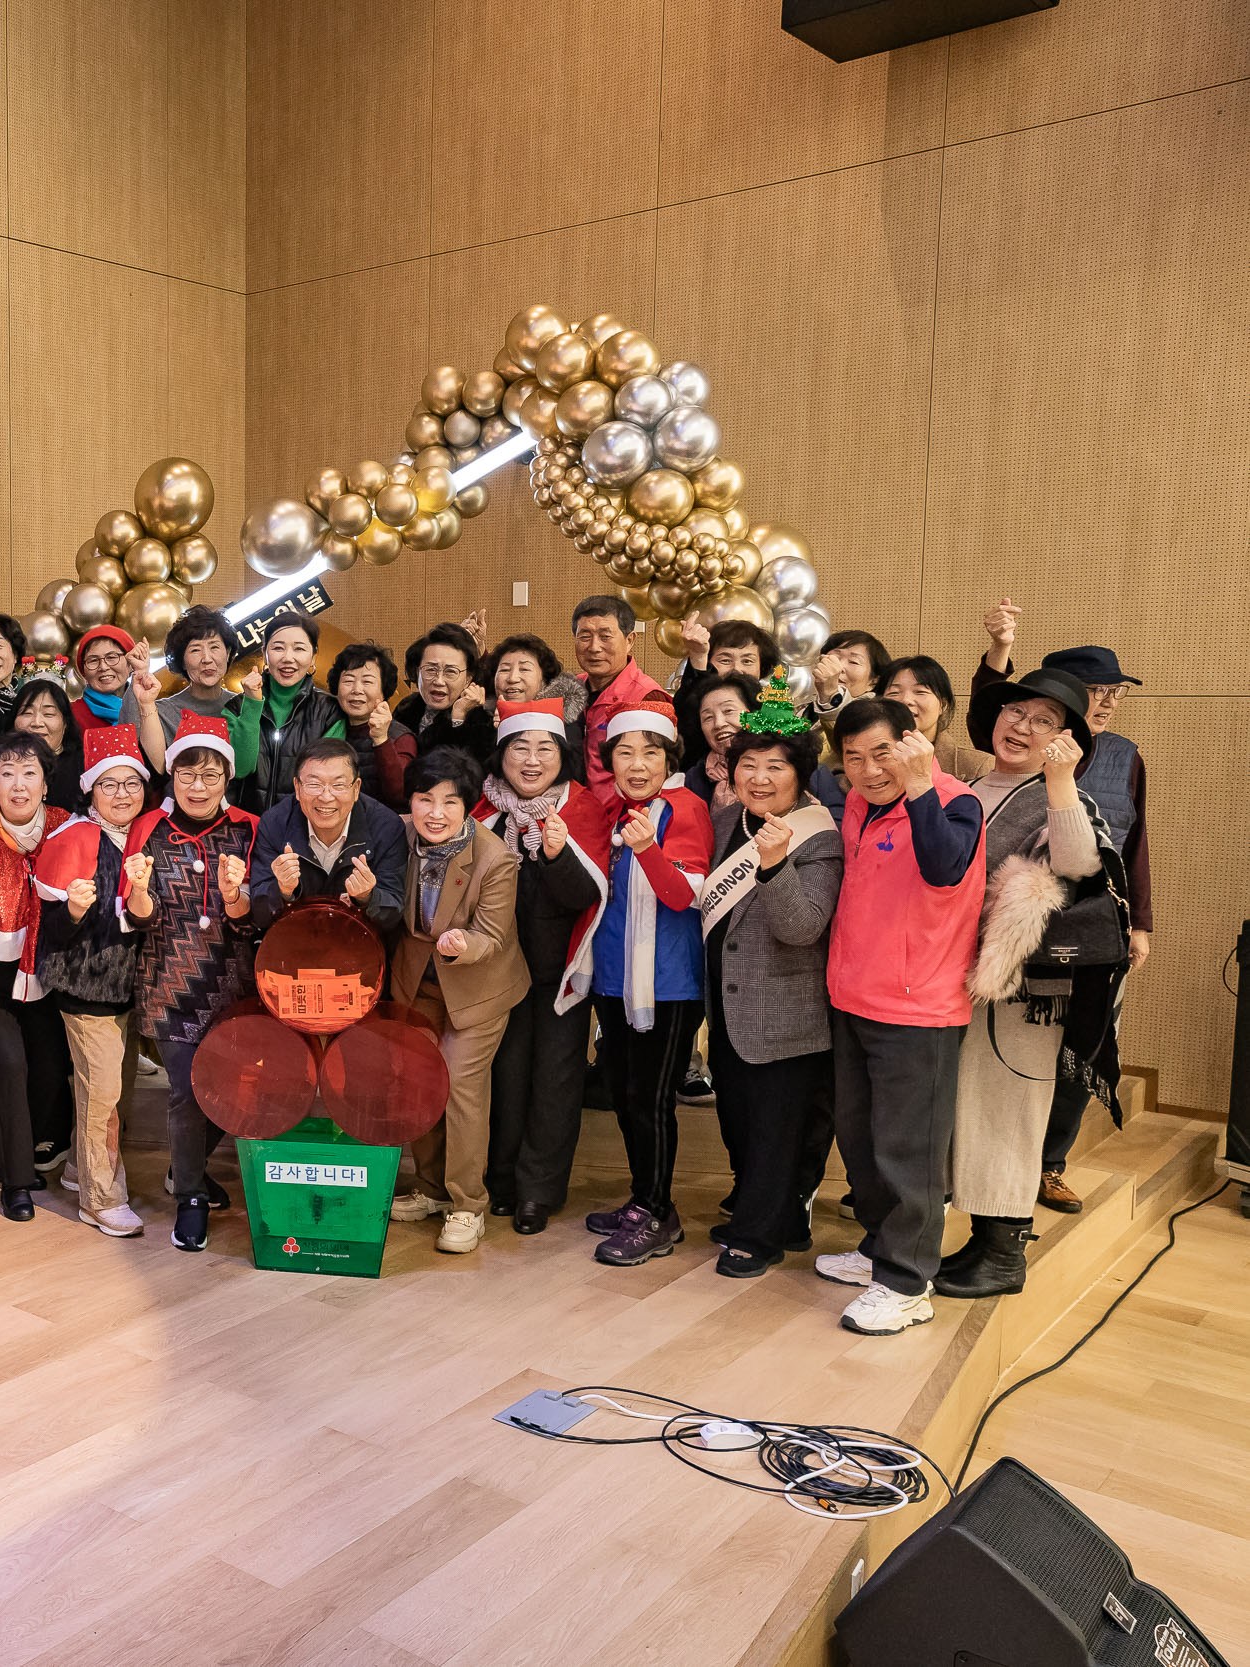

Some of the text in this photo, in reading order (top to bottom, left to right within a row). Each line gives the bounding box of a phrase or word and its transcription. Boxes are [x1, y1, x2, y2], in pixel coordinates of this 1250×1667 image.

[297, 585, 326, 614] 날
[715, 858, 755, 897] 2026
[268, 1165, 364, 1182] 감사합니다!
